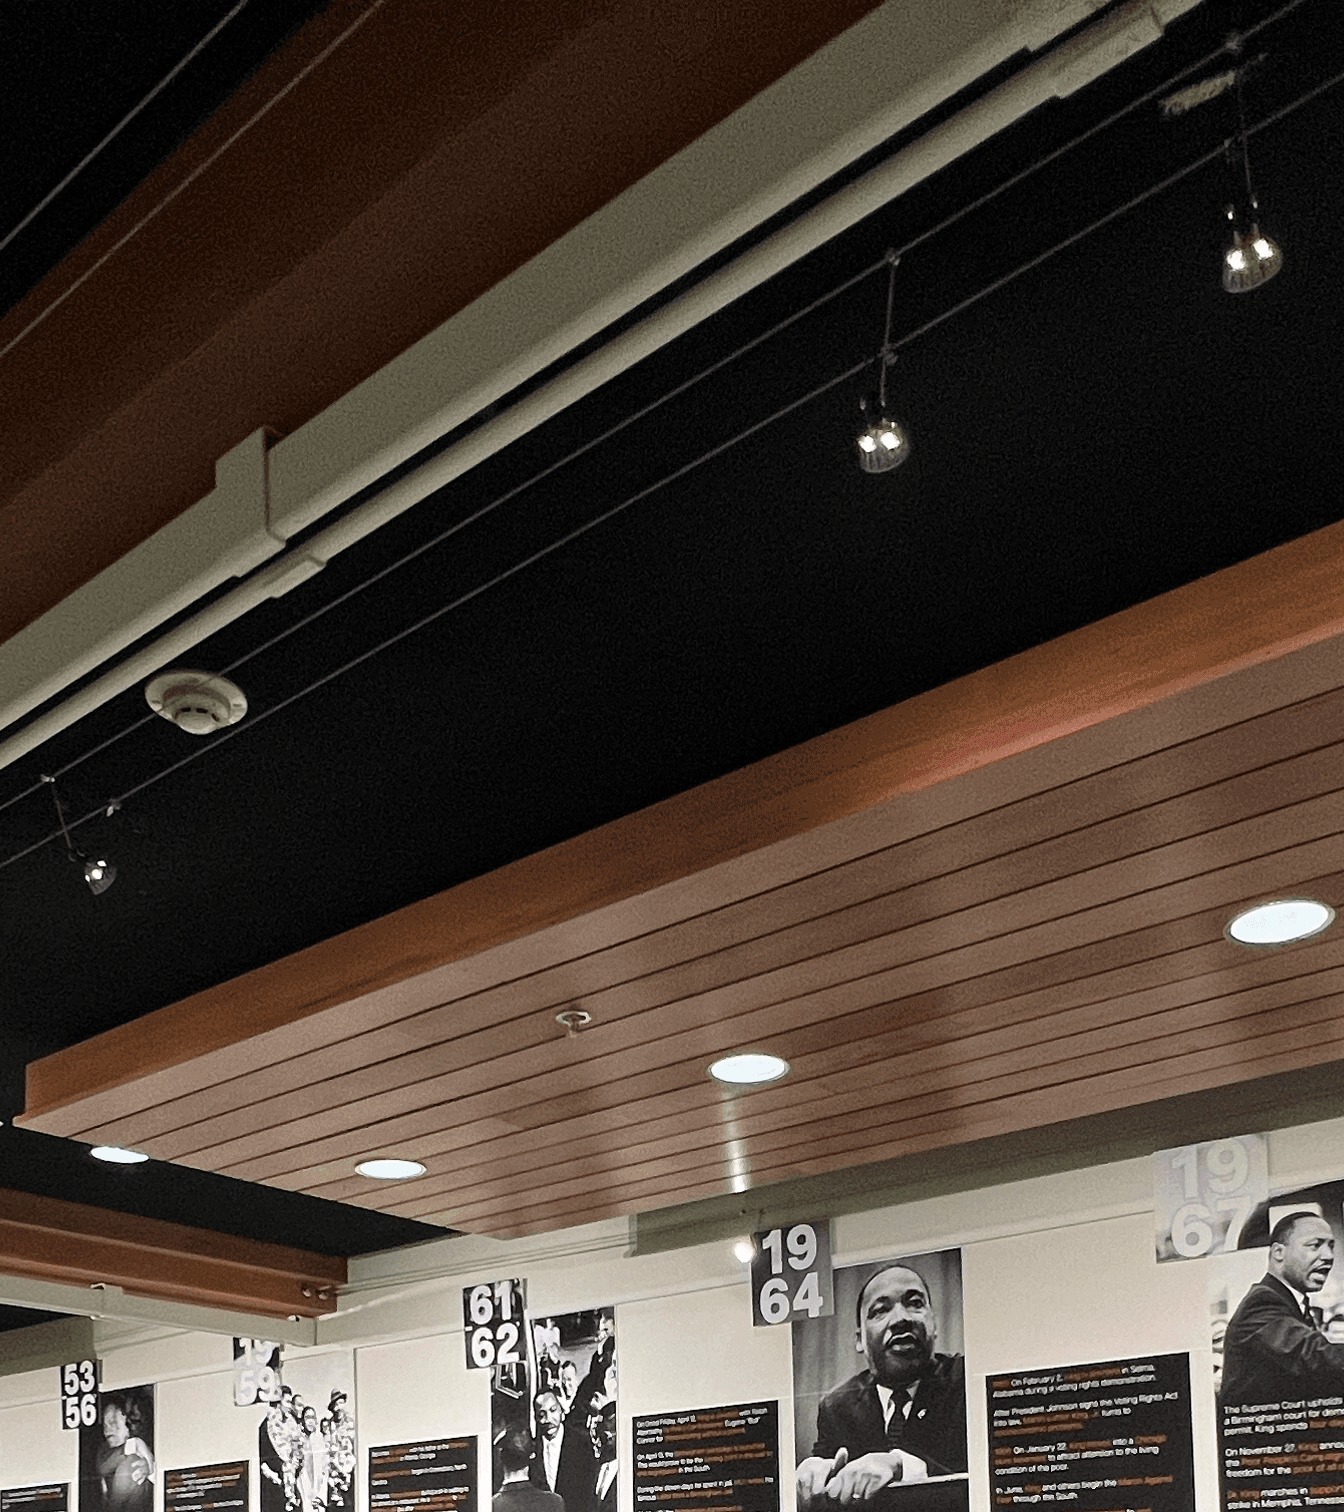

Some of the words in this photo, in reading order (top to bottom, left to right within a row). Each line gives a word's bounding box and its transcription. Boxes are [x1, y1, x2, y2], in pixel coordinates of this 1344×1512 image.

[1172, 1138, 1248, 1199] 19
[761, 1223, 817, 1275] 19
[1171, 1196, 1251, 1257] 67
[469, 1280, 514, 1325] 61
[760, 1272, 823, 1326] 64
[471, 1319, 520, 1368] 62
[64, 1360, 96, 1395] 53
[236, 1366, 276, 1404] 59
[65, 1393, 96, 1428] 56
